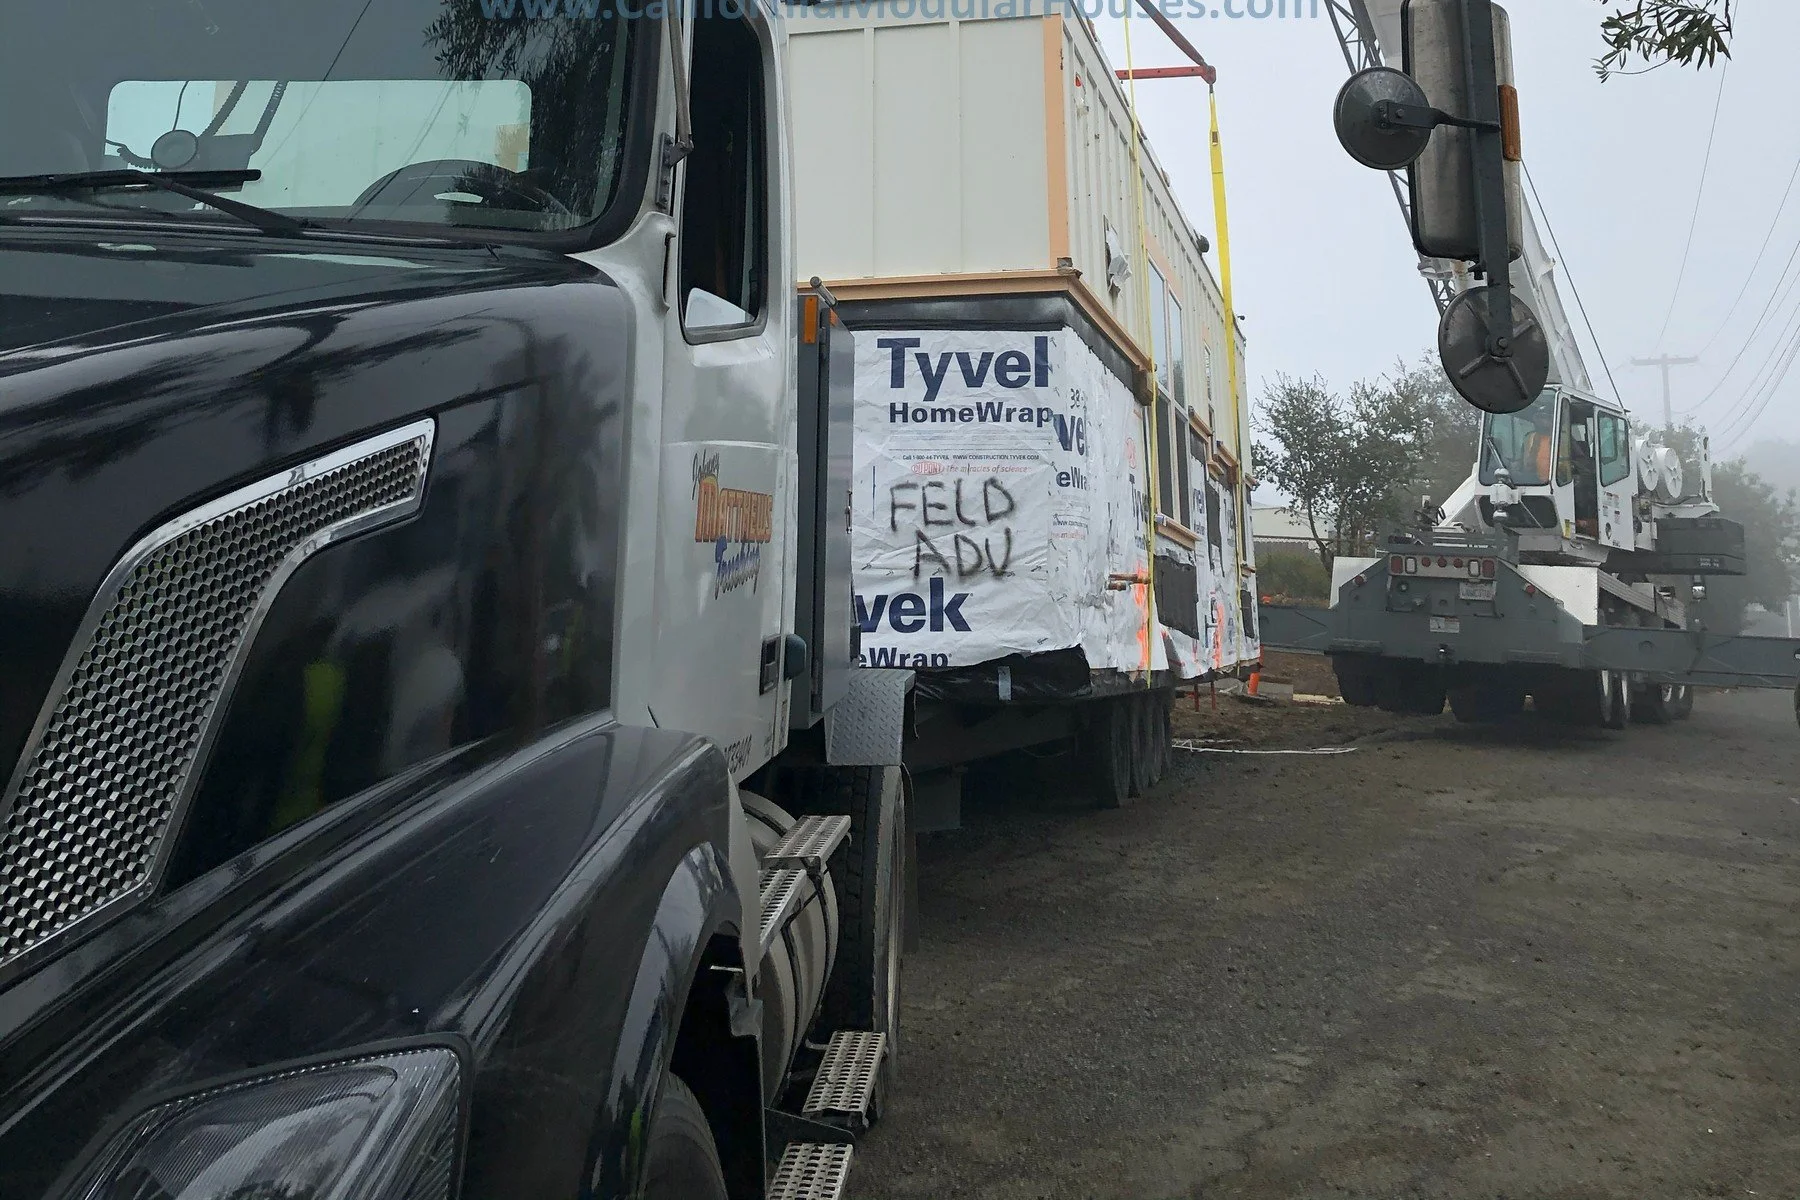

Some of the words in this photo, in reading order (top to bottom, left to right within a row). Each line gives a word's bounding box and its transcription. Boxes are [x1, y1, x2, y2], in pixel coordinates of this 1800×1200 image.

[889, 401, 1053, 428] HomeWrap
[991, 464, 1000, 474] of
[890, 477, 1015, 532] FELD
